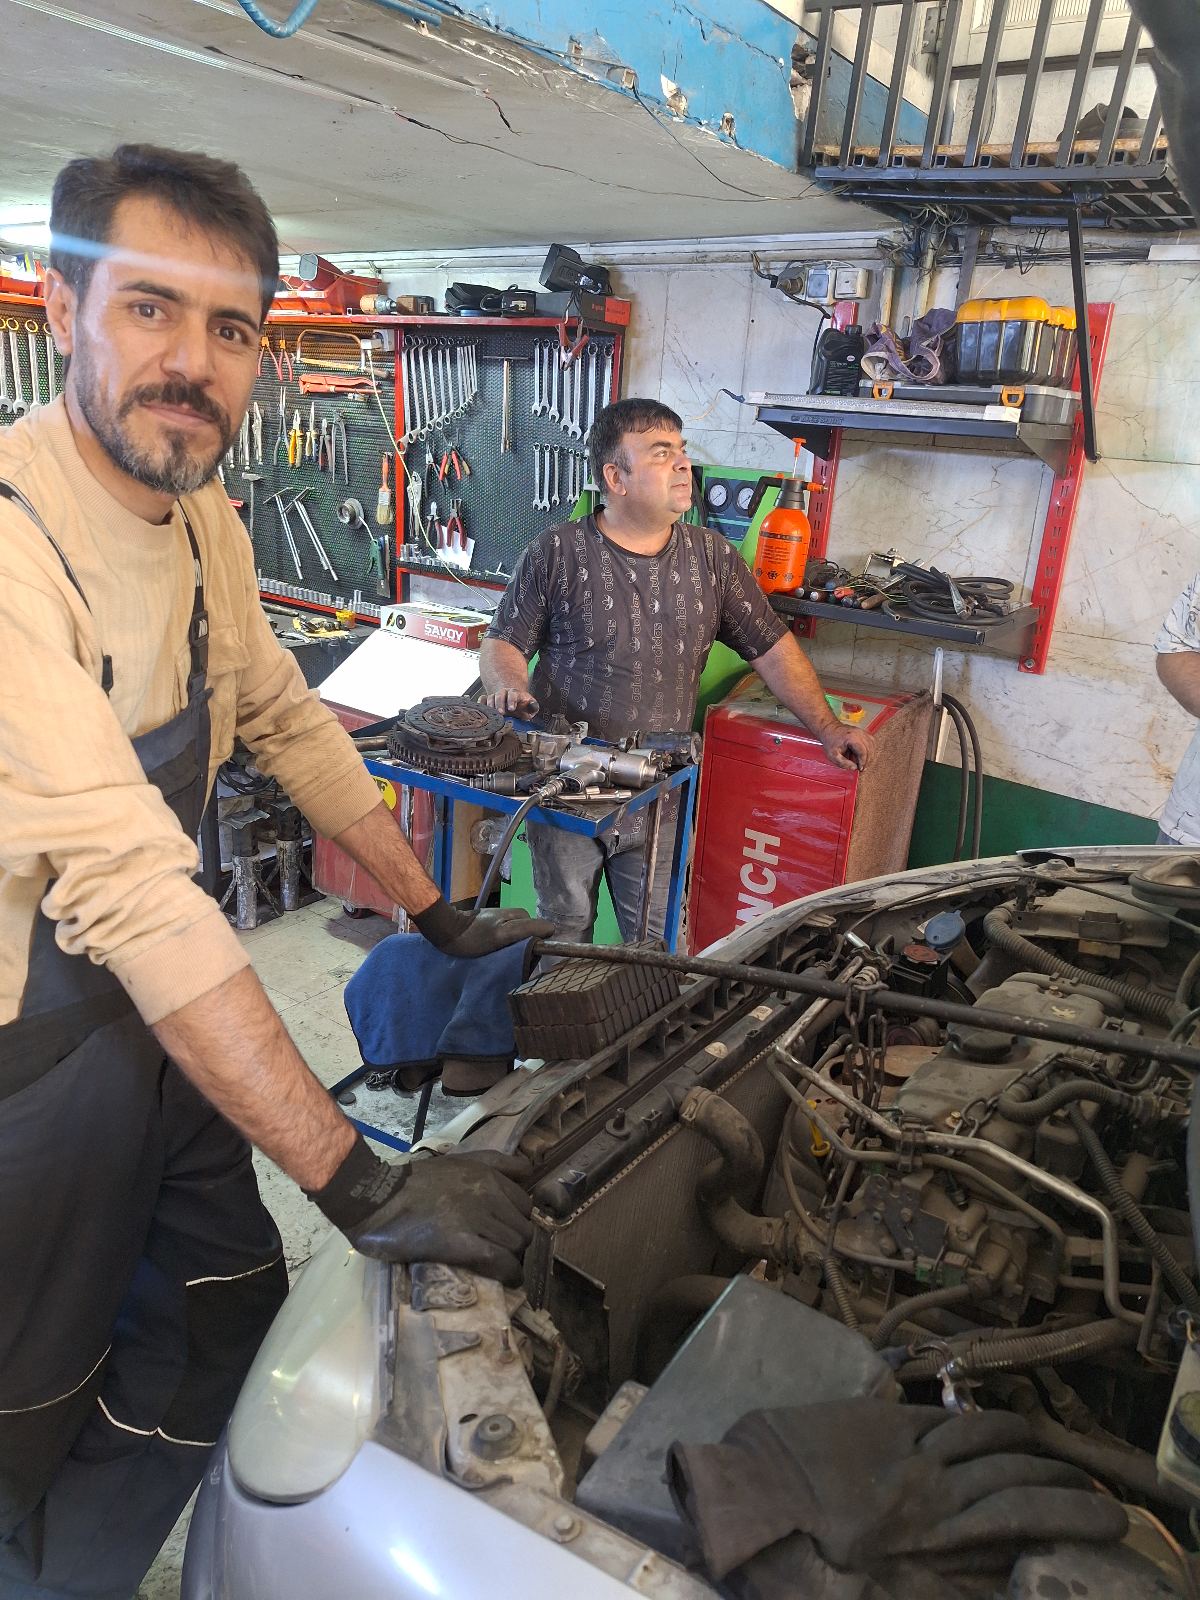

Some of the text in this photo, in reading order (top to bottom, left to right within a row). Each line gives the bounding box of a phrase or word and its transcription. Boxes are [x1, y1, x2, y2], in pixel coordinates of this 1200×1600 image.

[575, 529, 588, 564] adidas
[601, 551, 614, 592] adidas
[690, 555, 703, 596] adidas
[424, 622, 464, 641] SAVOY
[581, 590, 593, 634] adidas
[676, 593, 687, 637] adidas
[606, 619, 617, 661] adidas
[652, 622, 663, 665] adidas
[632, 660, 643, 702] adidas
[735, 828, 781, 931] NCH
